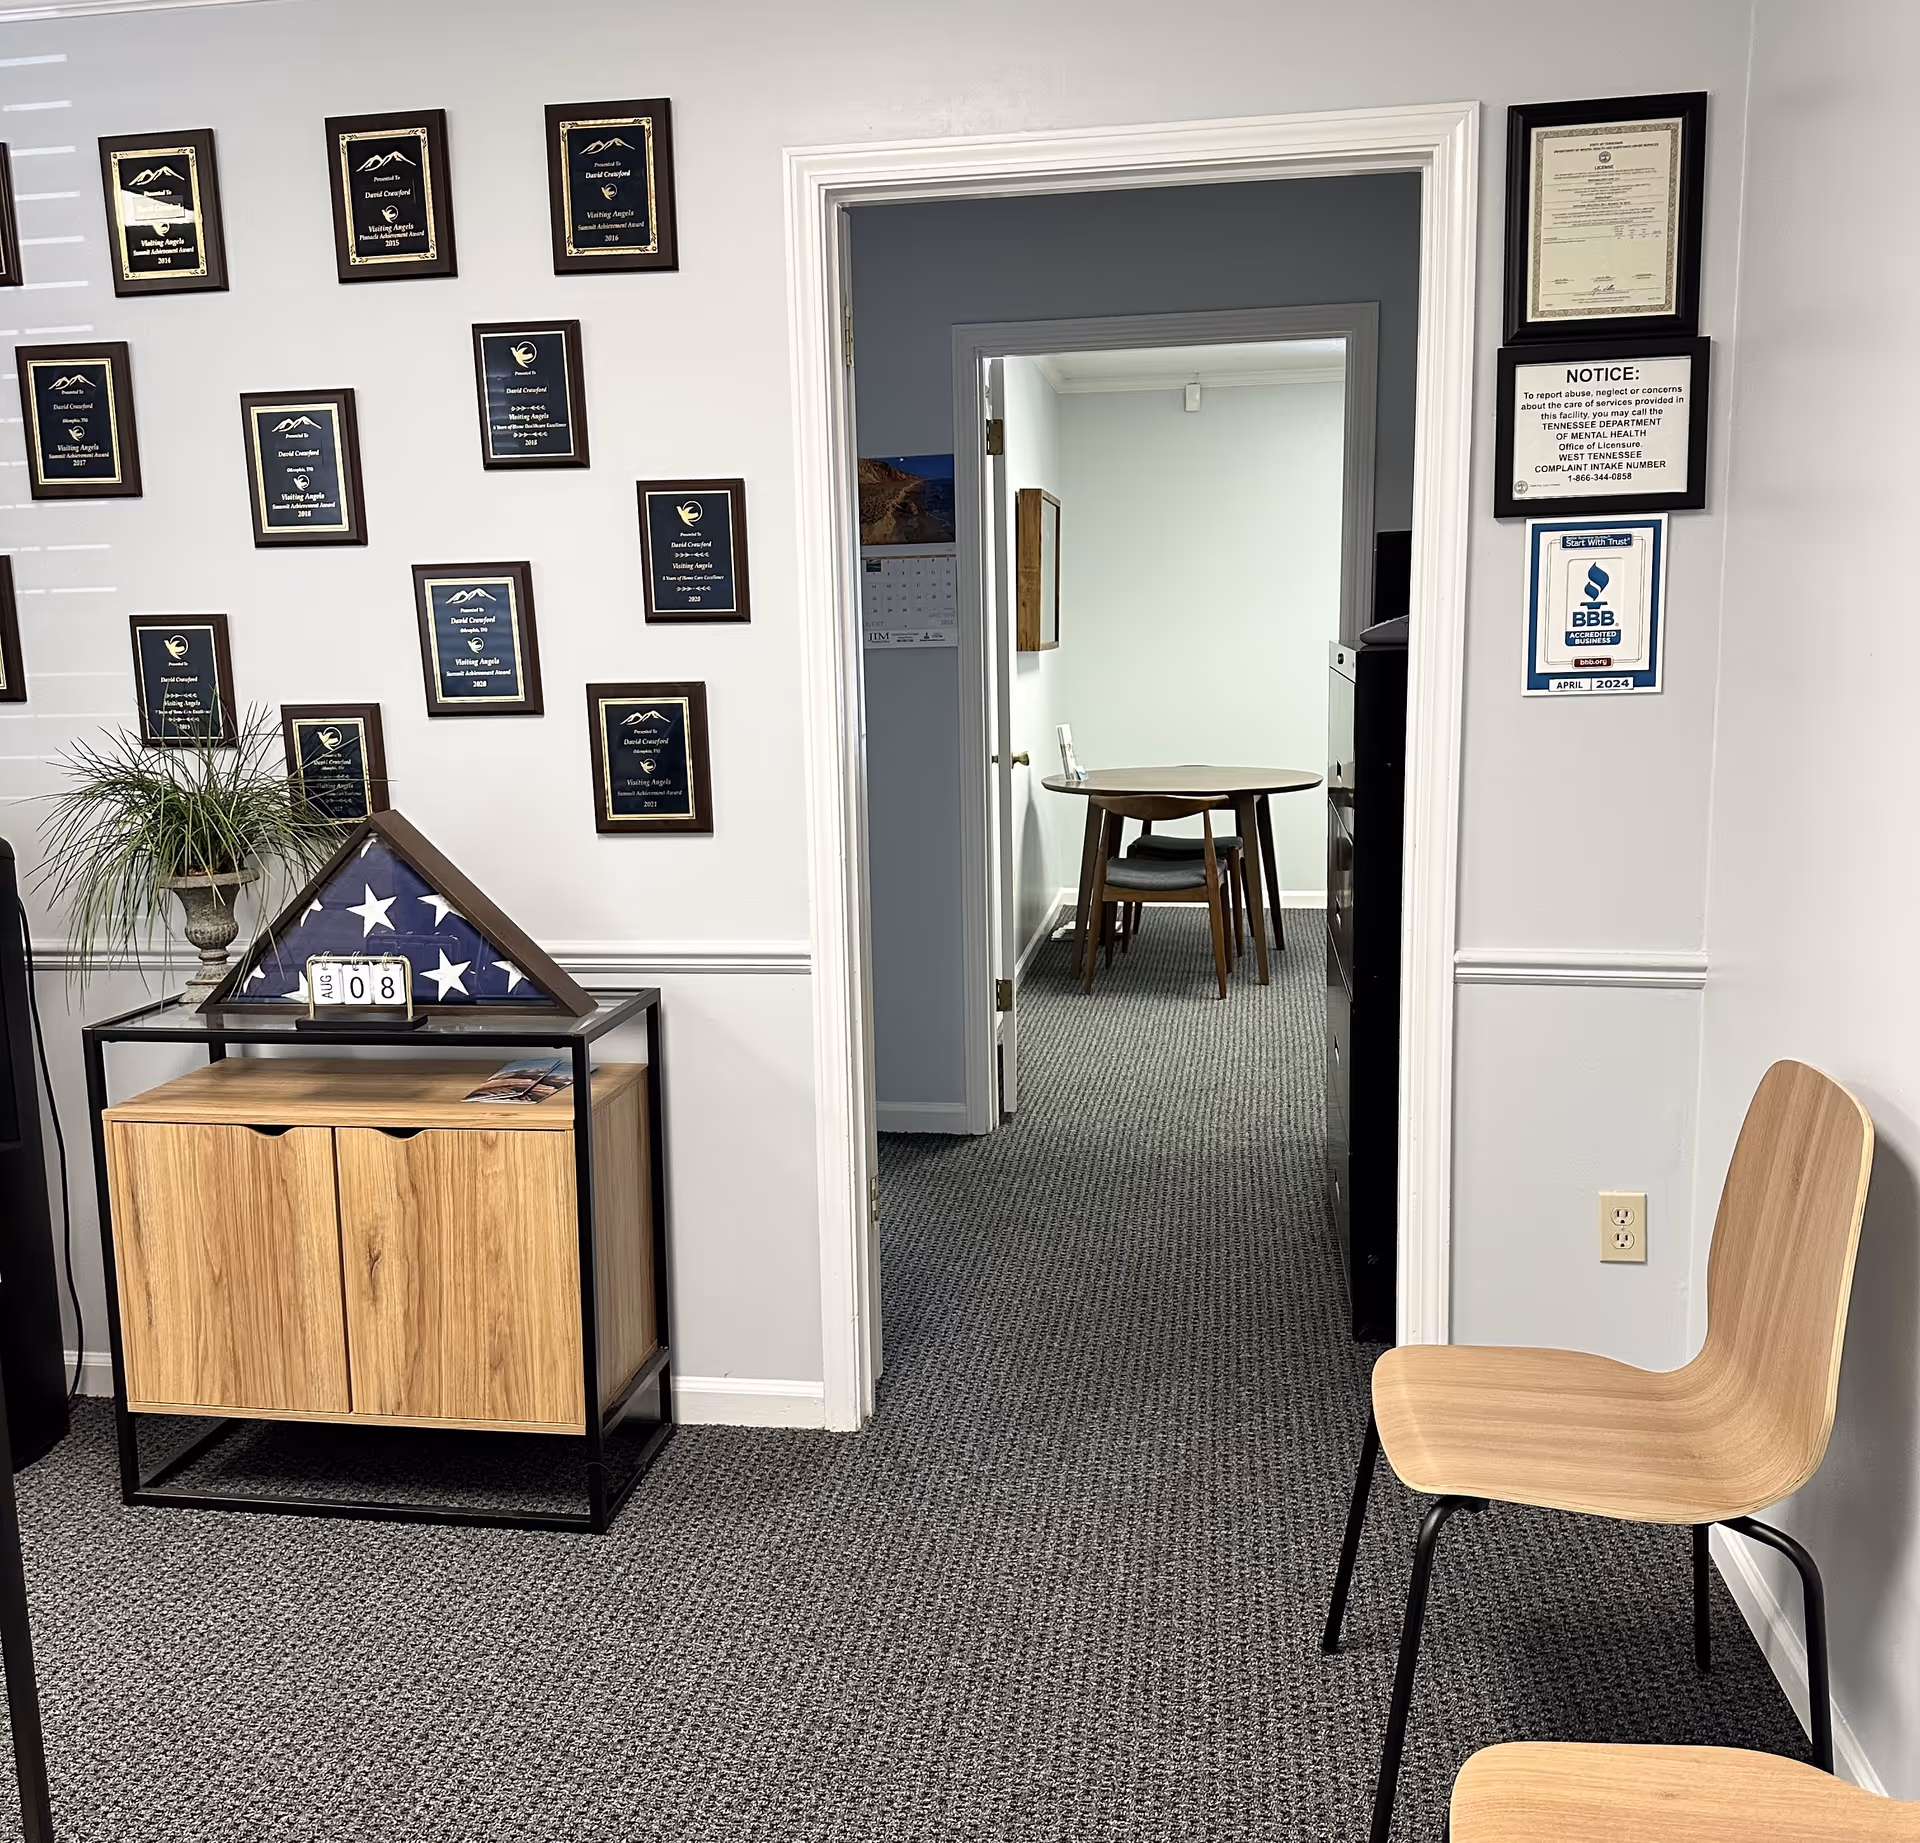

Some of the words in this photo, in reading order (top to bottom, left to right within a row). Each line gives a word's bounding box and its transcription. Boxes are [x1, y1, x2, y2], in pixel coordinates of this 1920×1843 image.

[604, 170, 630, 178] Crawford
[365, 191, 382, 199] David
[384, 189, 410, 197] Crawford
[368, 225, 392, 233] Visiting
[1567, 367, 1639, 383] NOTICE:
[1537, 390, 1562, 400] report
[1565, 390, 1593, 398] abuse,
[1596, 388, 1627, 397] neglect
[1642, 386, 1682, 394] concerns
[1521, 402, 1545, 410] about
[1596, 398, 1632, 407] services
[1635, 397, 1673, 406] provided
[1559, 411, 1590, 420] facility,
[1592, 411, 1608, 419] you
[1611, 410, 1629, 418] may
[1632, 408, 1646, 416] call
[1543, 421, 1596, 430] TENNESSEE
[1600, 419, 1661, 428] DEPARTMENT
[1571, 432, 1608, 440] MENTAL
[1610, 430, 1646, 438] HEALTH
[1588, 451, 1642, 460] TENNESSEE
[1535, 464, 1588, 473] COMPLAINT
[1591, 462, 1623, 471] INTAKE
[1626, 461, 1666, 469] NUMBER
[1568, 473, 1632, 482] 1-866-344-0858
[282, 493, 304, 501] Visiting
[305, 492, 325, 501] Angels
[1566, 539, 1585, 547] Start
[1588, 538, 1605, 546] With
[694, 562, 712, 570] Angels
[469, 616, 495, 624] Crawford
[1570, 631, 1617, 639] ACCREDITED
[455, 658, 478, 666] Visiting
[479, 657, 499, 666] Angels
[1557, 681, 1583, 689] APRIL
[1596, 680, 1630, 688] 2024
[642, 738, 669, 746] Crawford
[627, 779, 650, 787] Visiting
[651, 779, 671, 787] Angels
[320, 975, 334, 999] AUG
